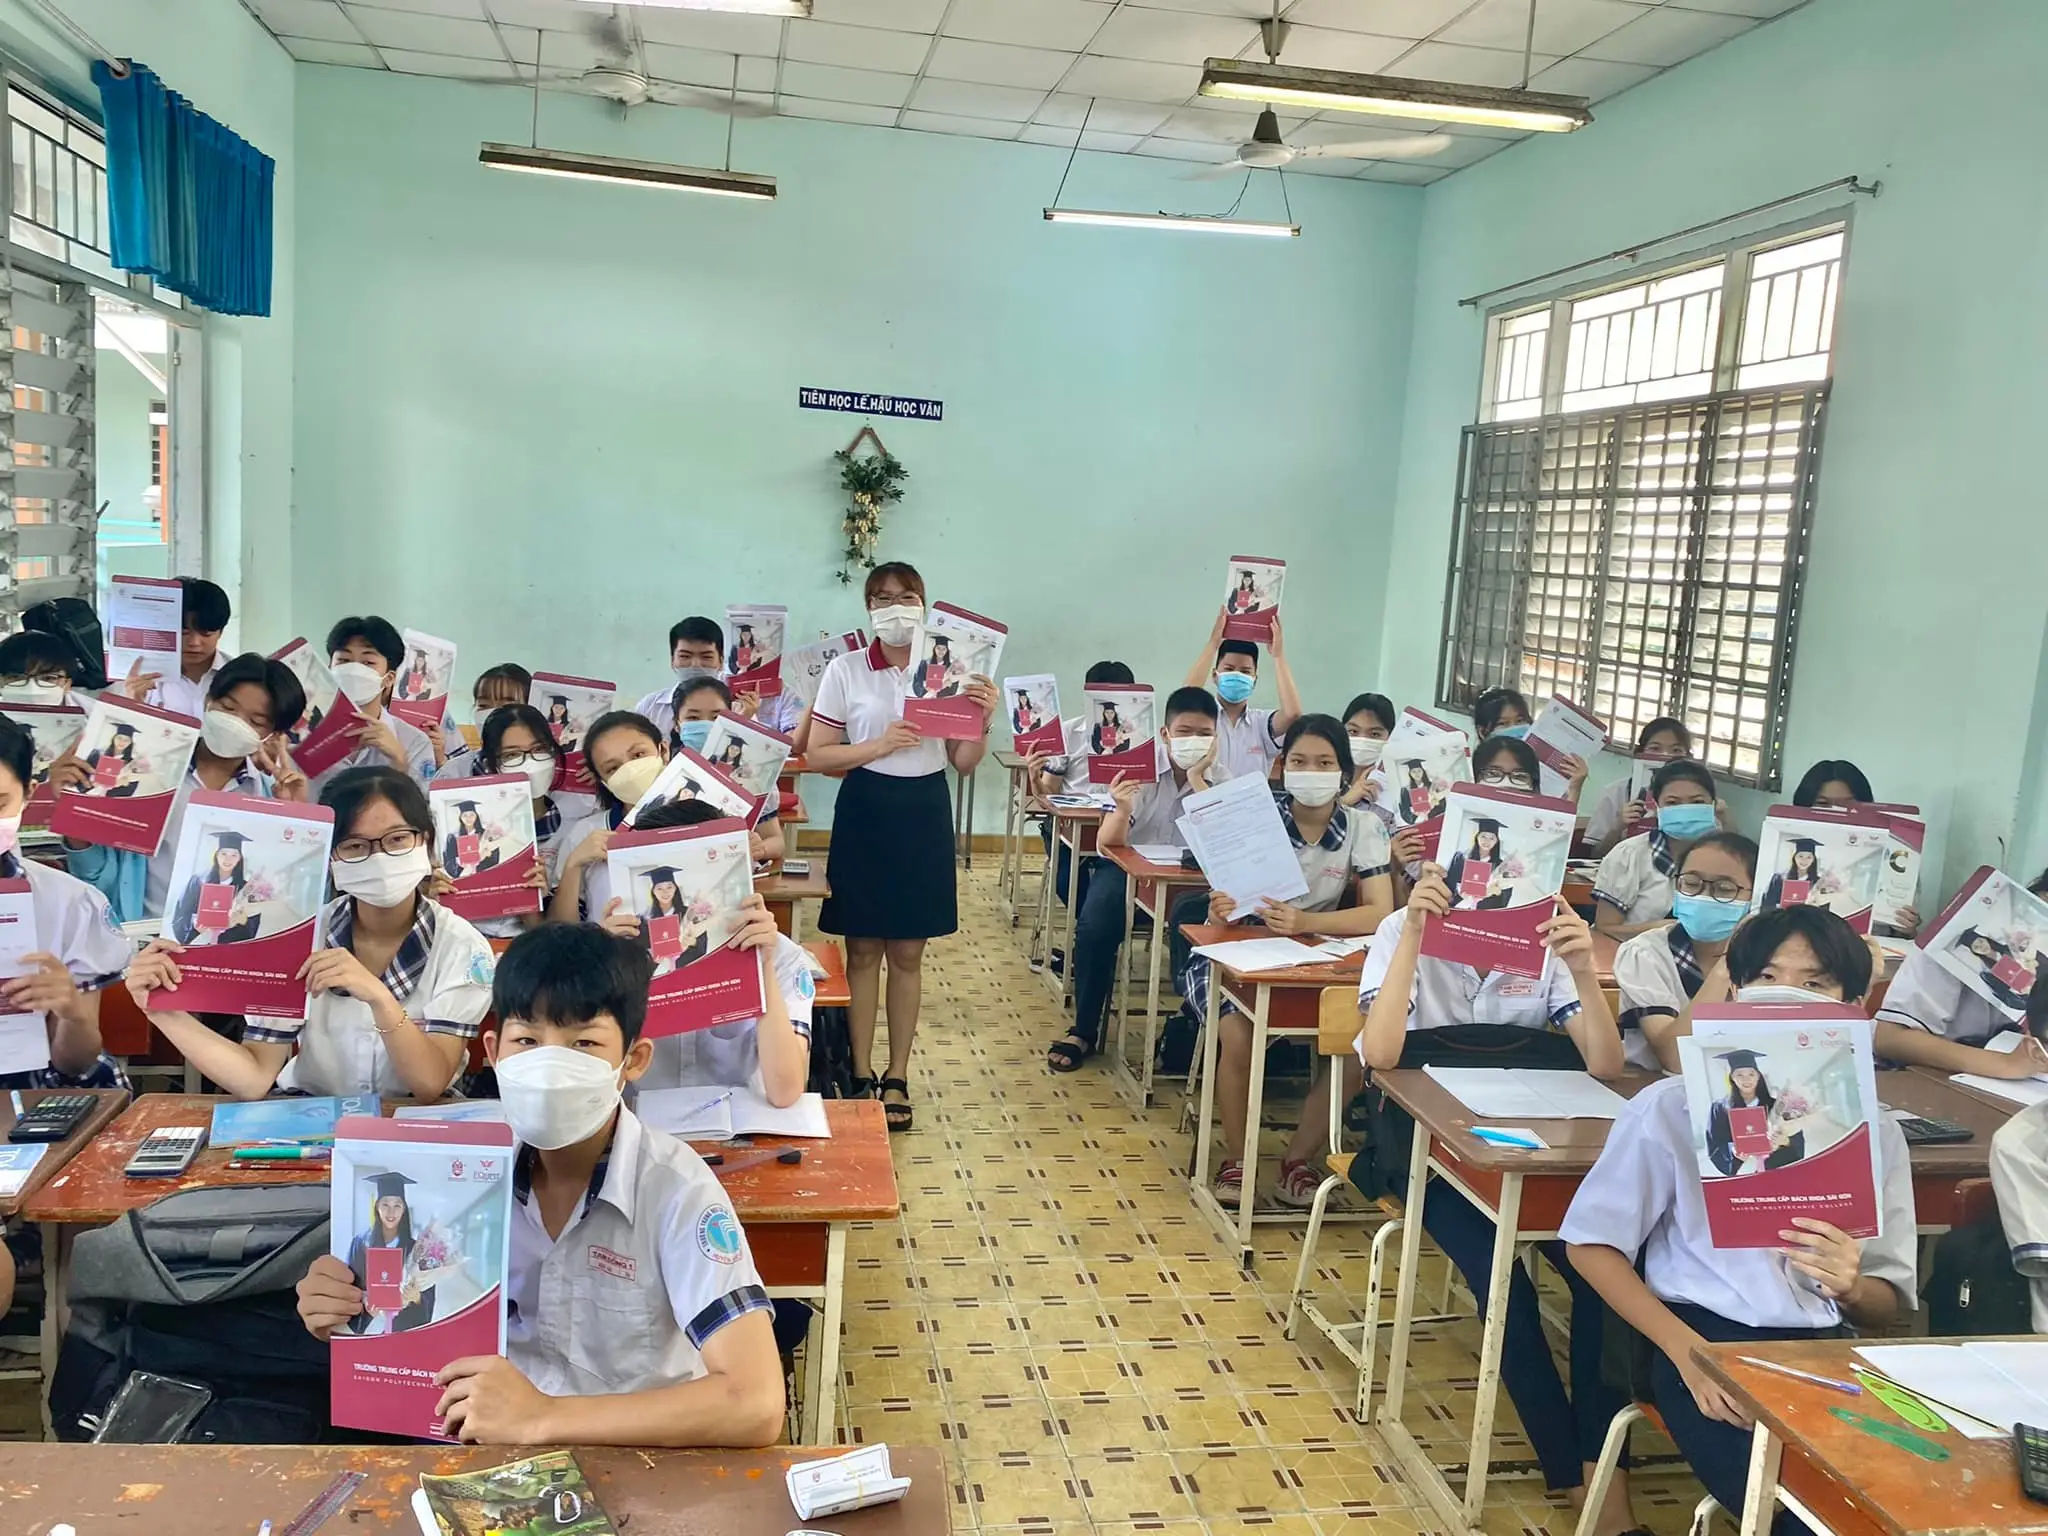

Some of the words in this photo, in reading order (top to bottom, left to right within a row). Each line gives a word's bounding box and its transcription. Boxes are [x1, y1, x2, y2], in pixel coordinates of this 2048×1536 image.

[801, 389, 826, 405] TIÊN
[829, 393, 851, 411] HỌC
[895, 400, 917, 417] HỌC
[920, 402, 941, 417] VĂN
